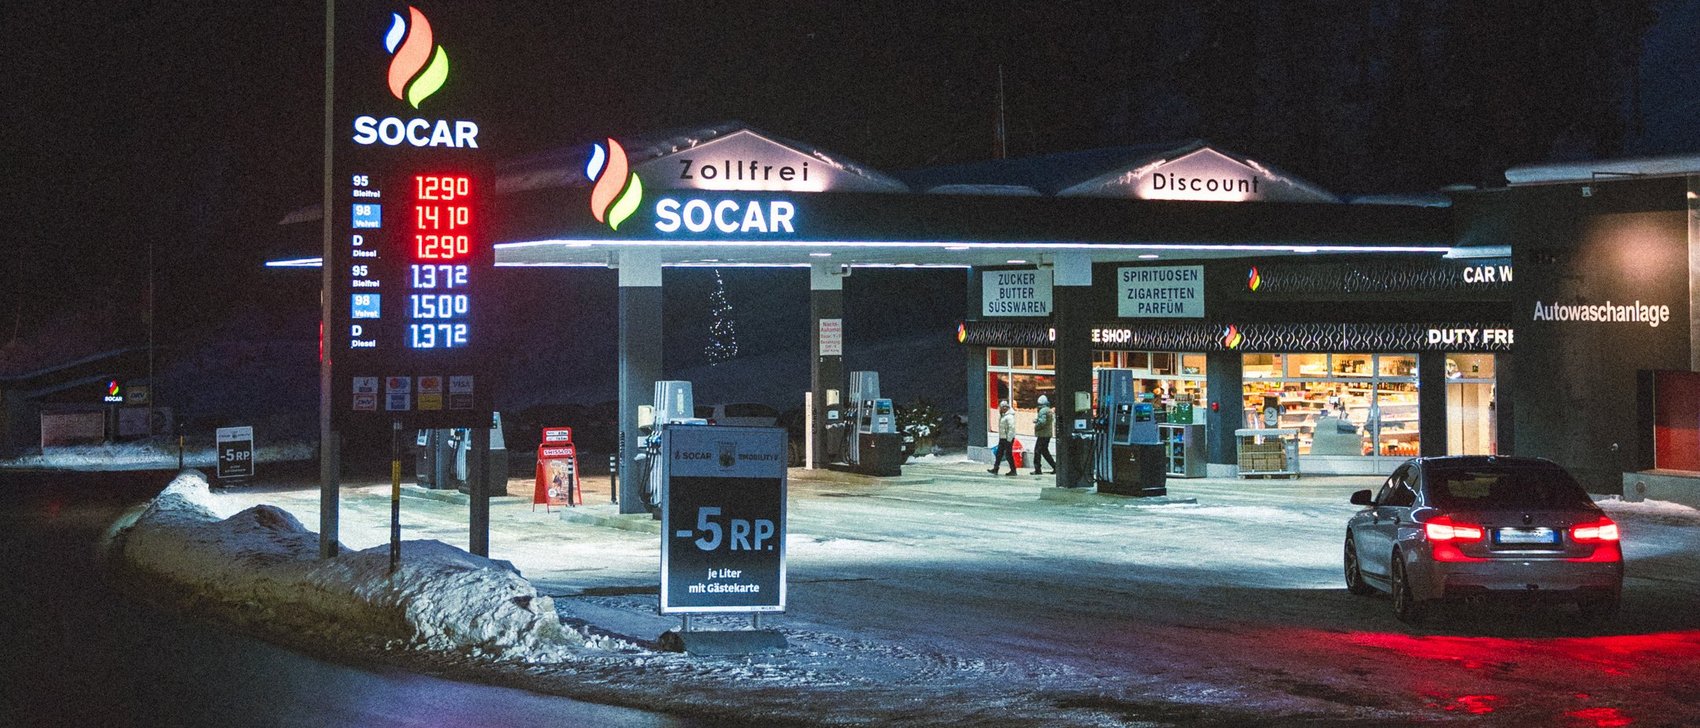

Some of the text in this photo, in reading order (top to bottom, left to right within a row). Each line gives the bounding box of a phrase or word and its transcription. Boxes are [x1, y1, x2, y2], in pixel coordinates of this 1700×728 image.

[353, 115, 478, 149] SOCAR
[679, 159, 808, 181] Zollfrei
[353, 175, 369, 187] 95
[1153, 173, 1259, 193] Discount
[355, 205, 371, 216] 98
[655, 198, 795, 233] SOCAR
[353, 235, 363, 246] D
[352, 265, 368, 276] 95
[1123, 269, 1198, 283] SPIRITUOSEN
[1463, 266, 1495, 283] CAR
[998, 273, 1035, 286] ZUCKER
[999, 288, 1034, 299] BUTTER
[1127, 288, 1194, 300] ZIGARETTEN
[355, 294, 371, 306] 98
[988, 298, 1046, 313] SÜSSWAREN
[1138, 298, 1184, 314] PARFÜM
[1533, 300, 1670, 327] Autowaschanlage
[352, 325, 362, 336] D
[1102, 328, 1131, 342] SHOP
[1428, 329, 1478, 345] DUTY
[352, 339, 376, 348] Diesel
[220, 449, 235, 461] -5
[682, 452, 712, 460] SOCAR
[676, 506, 775, 551] -5 RP.
[707, 568, 742, 580] je Liter
[688, 582, 760, 594] mit Gästekarte
